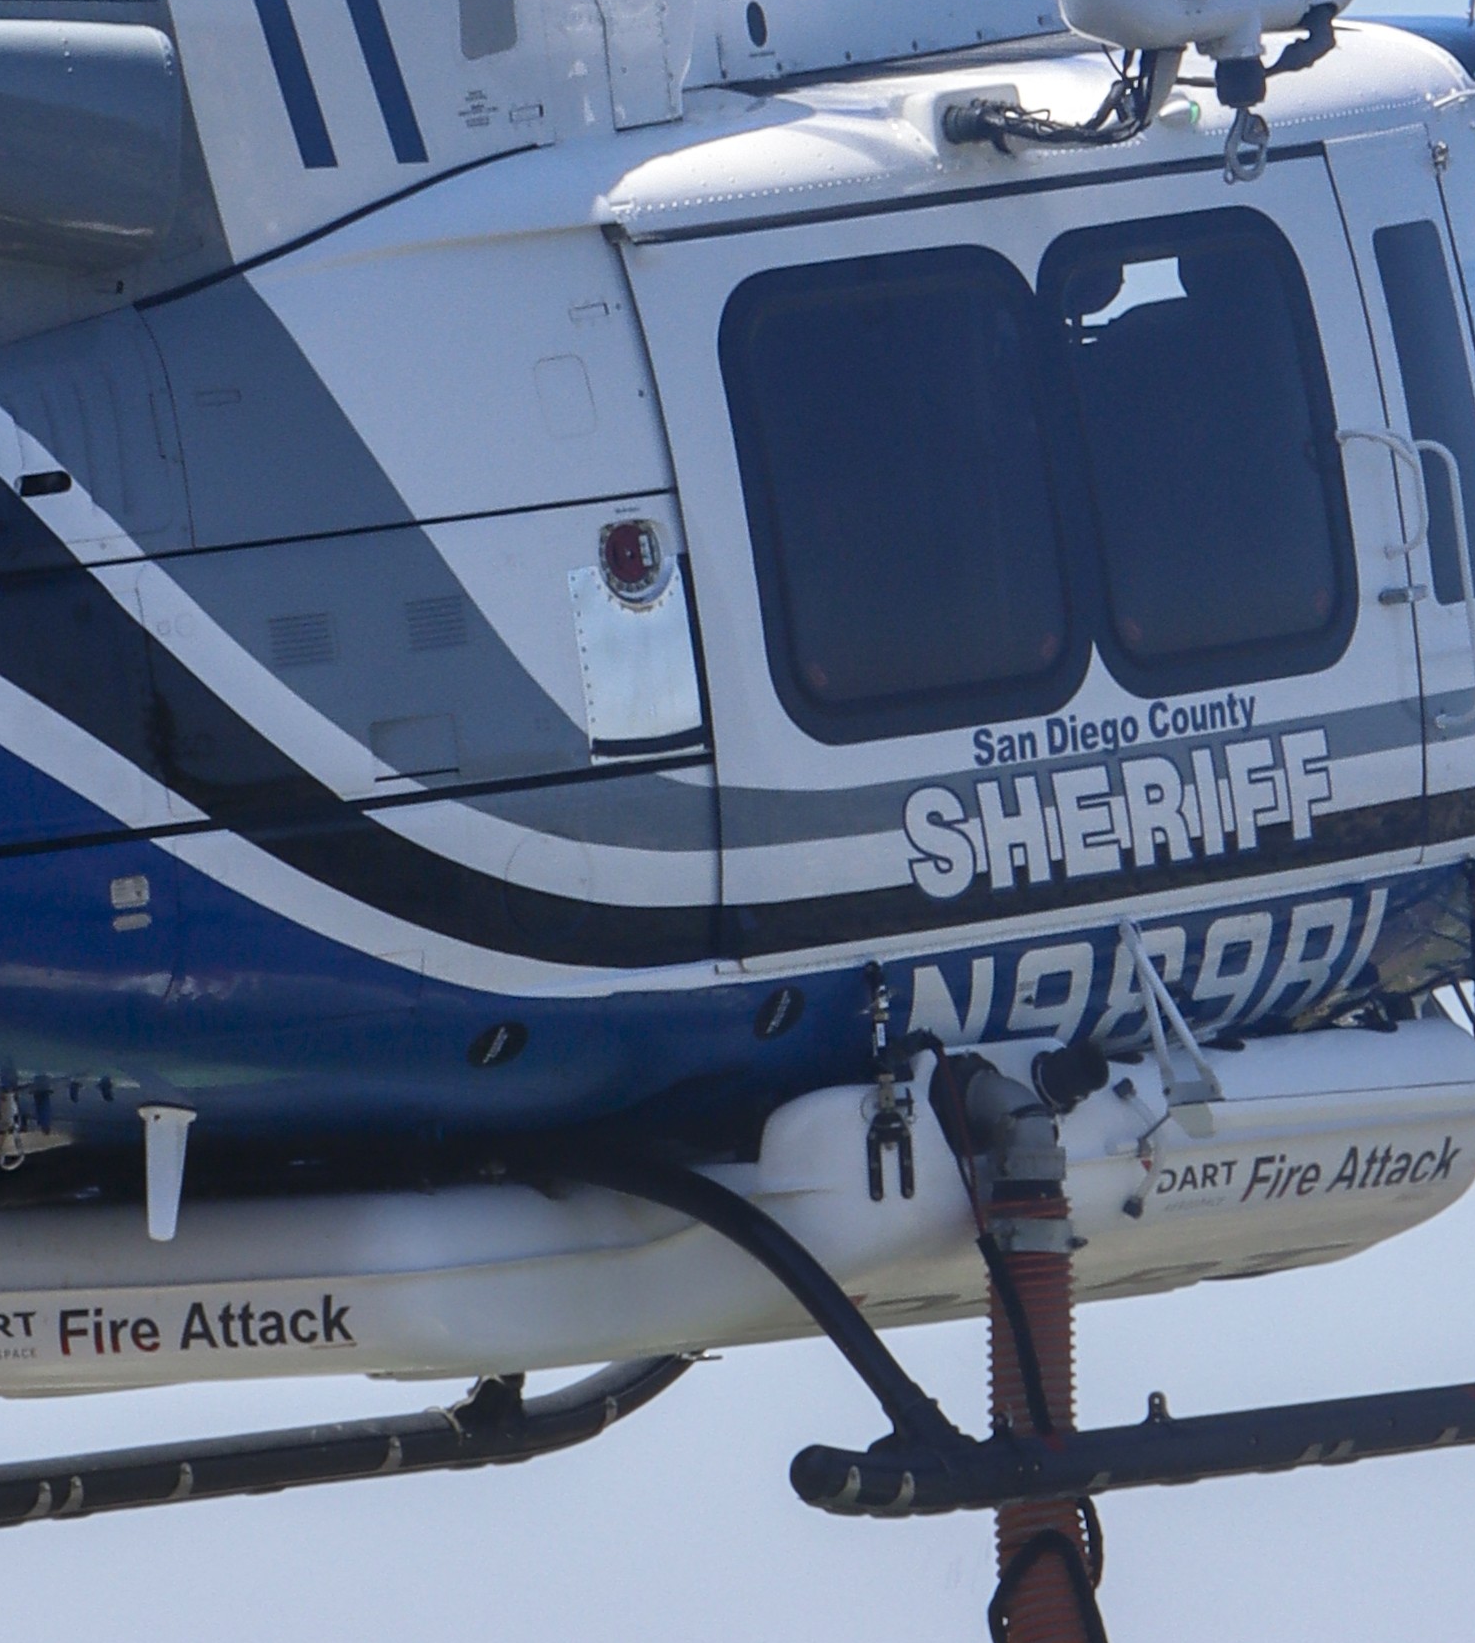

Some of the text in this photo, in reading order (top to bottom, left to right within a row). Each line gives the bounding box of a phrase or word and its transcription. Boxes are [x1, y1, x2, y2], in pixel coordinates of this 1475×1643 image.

[973, 692, 1256, 767] San Diego County
[902, 727, 1333, 901] SHERIFF
[1156, 1135, 1464, 1204] DART Fire Attack
[58, 1307, 161, 1356] Fire
[180, 1294, 353, 1351] Attack
